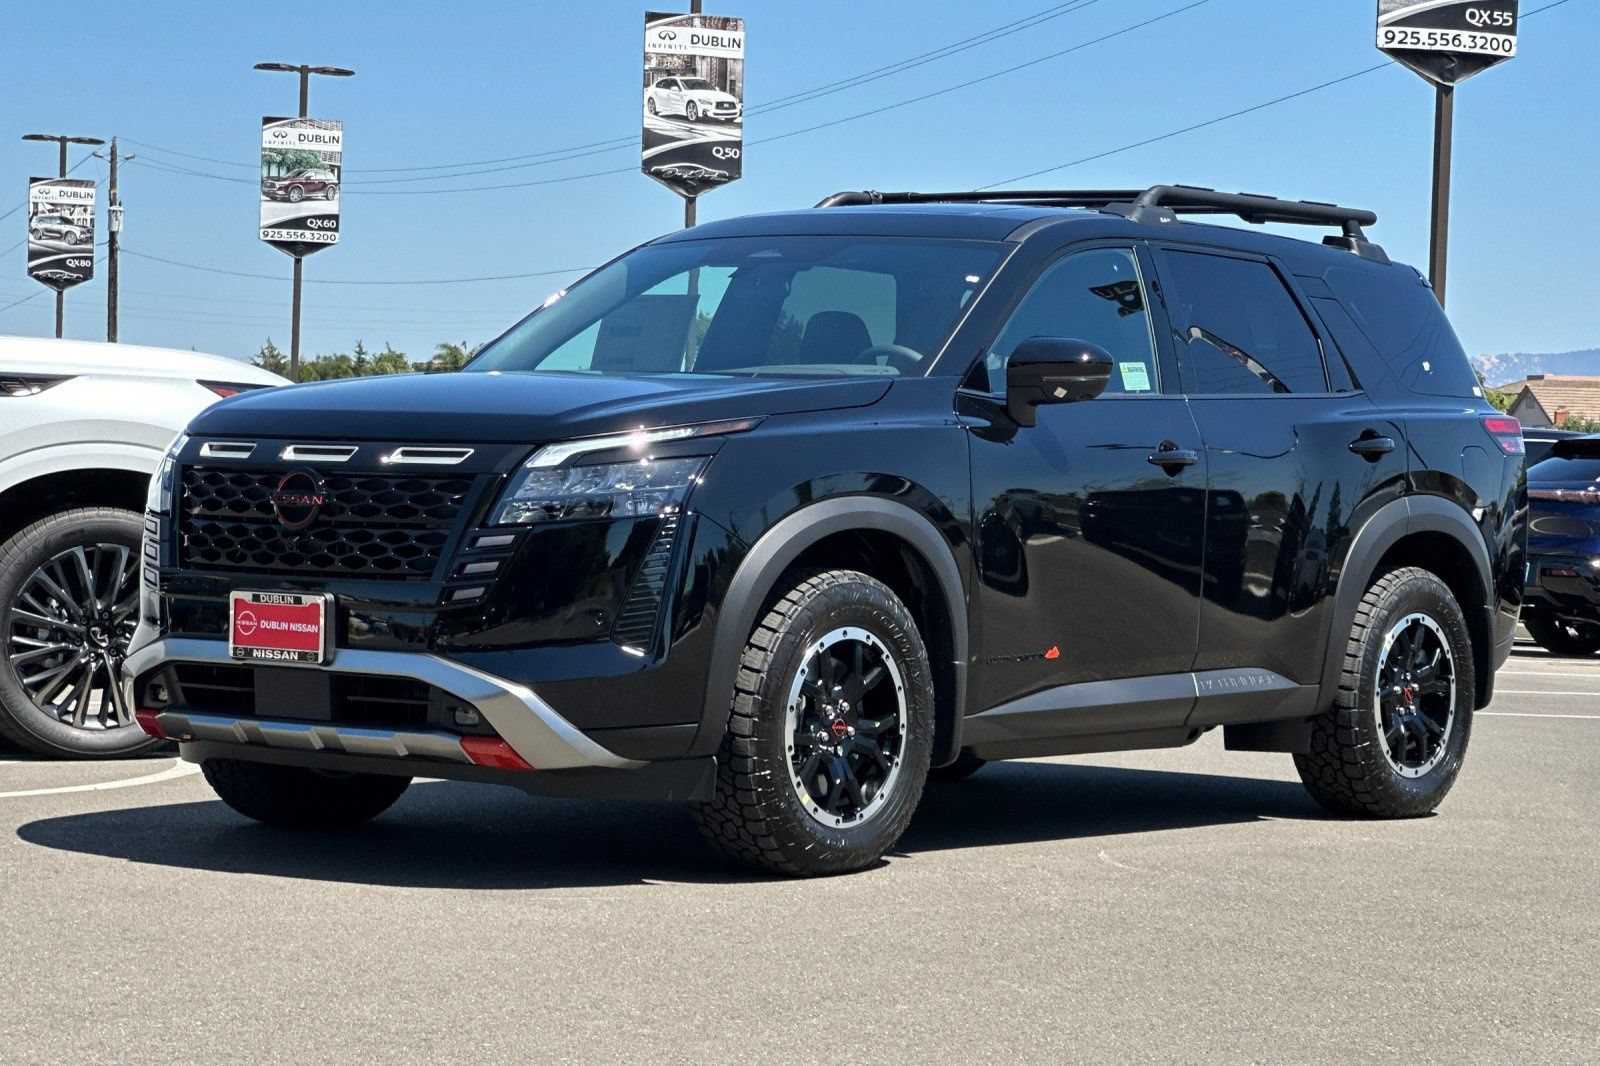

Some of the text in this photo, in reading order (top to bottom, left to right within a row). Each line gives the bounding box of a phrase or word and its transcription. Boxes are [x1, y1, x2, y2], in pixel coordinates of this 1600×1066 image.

[1465, 7, 1514, 27] QX55
[647, 34, 742, 51] INFINITI DUBLIN
[1384, 29, 1513, 53] 925.556.3200
[298, 133, 341, 145] DUBLIN
[712, 146, 740, 160] Q50
[59, 190, 94, 200] DUBLIN
[306, 218, 337, 230] QX60
[262, 230, 337, 242] 925.556.3200
[66, 258, 92, 268] QX80
[260, 594, 295, 605] DUBLIN
[236, 619, 319, 634] NISSAN DUBLIN NISSAN
[252, 648, 299, 661] NISSAN
